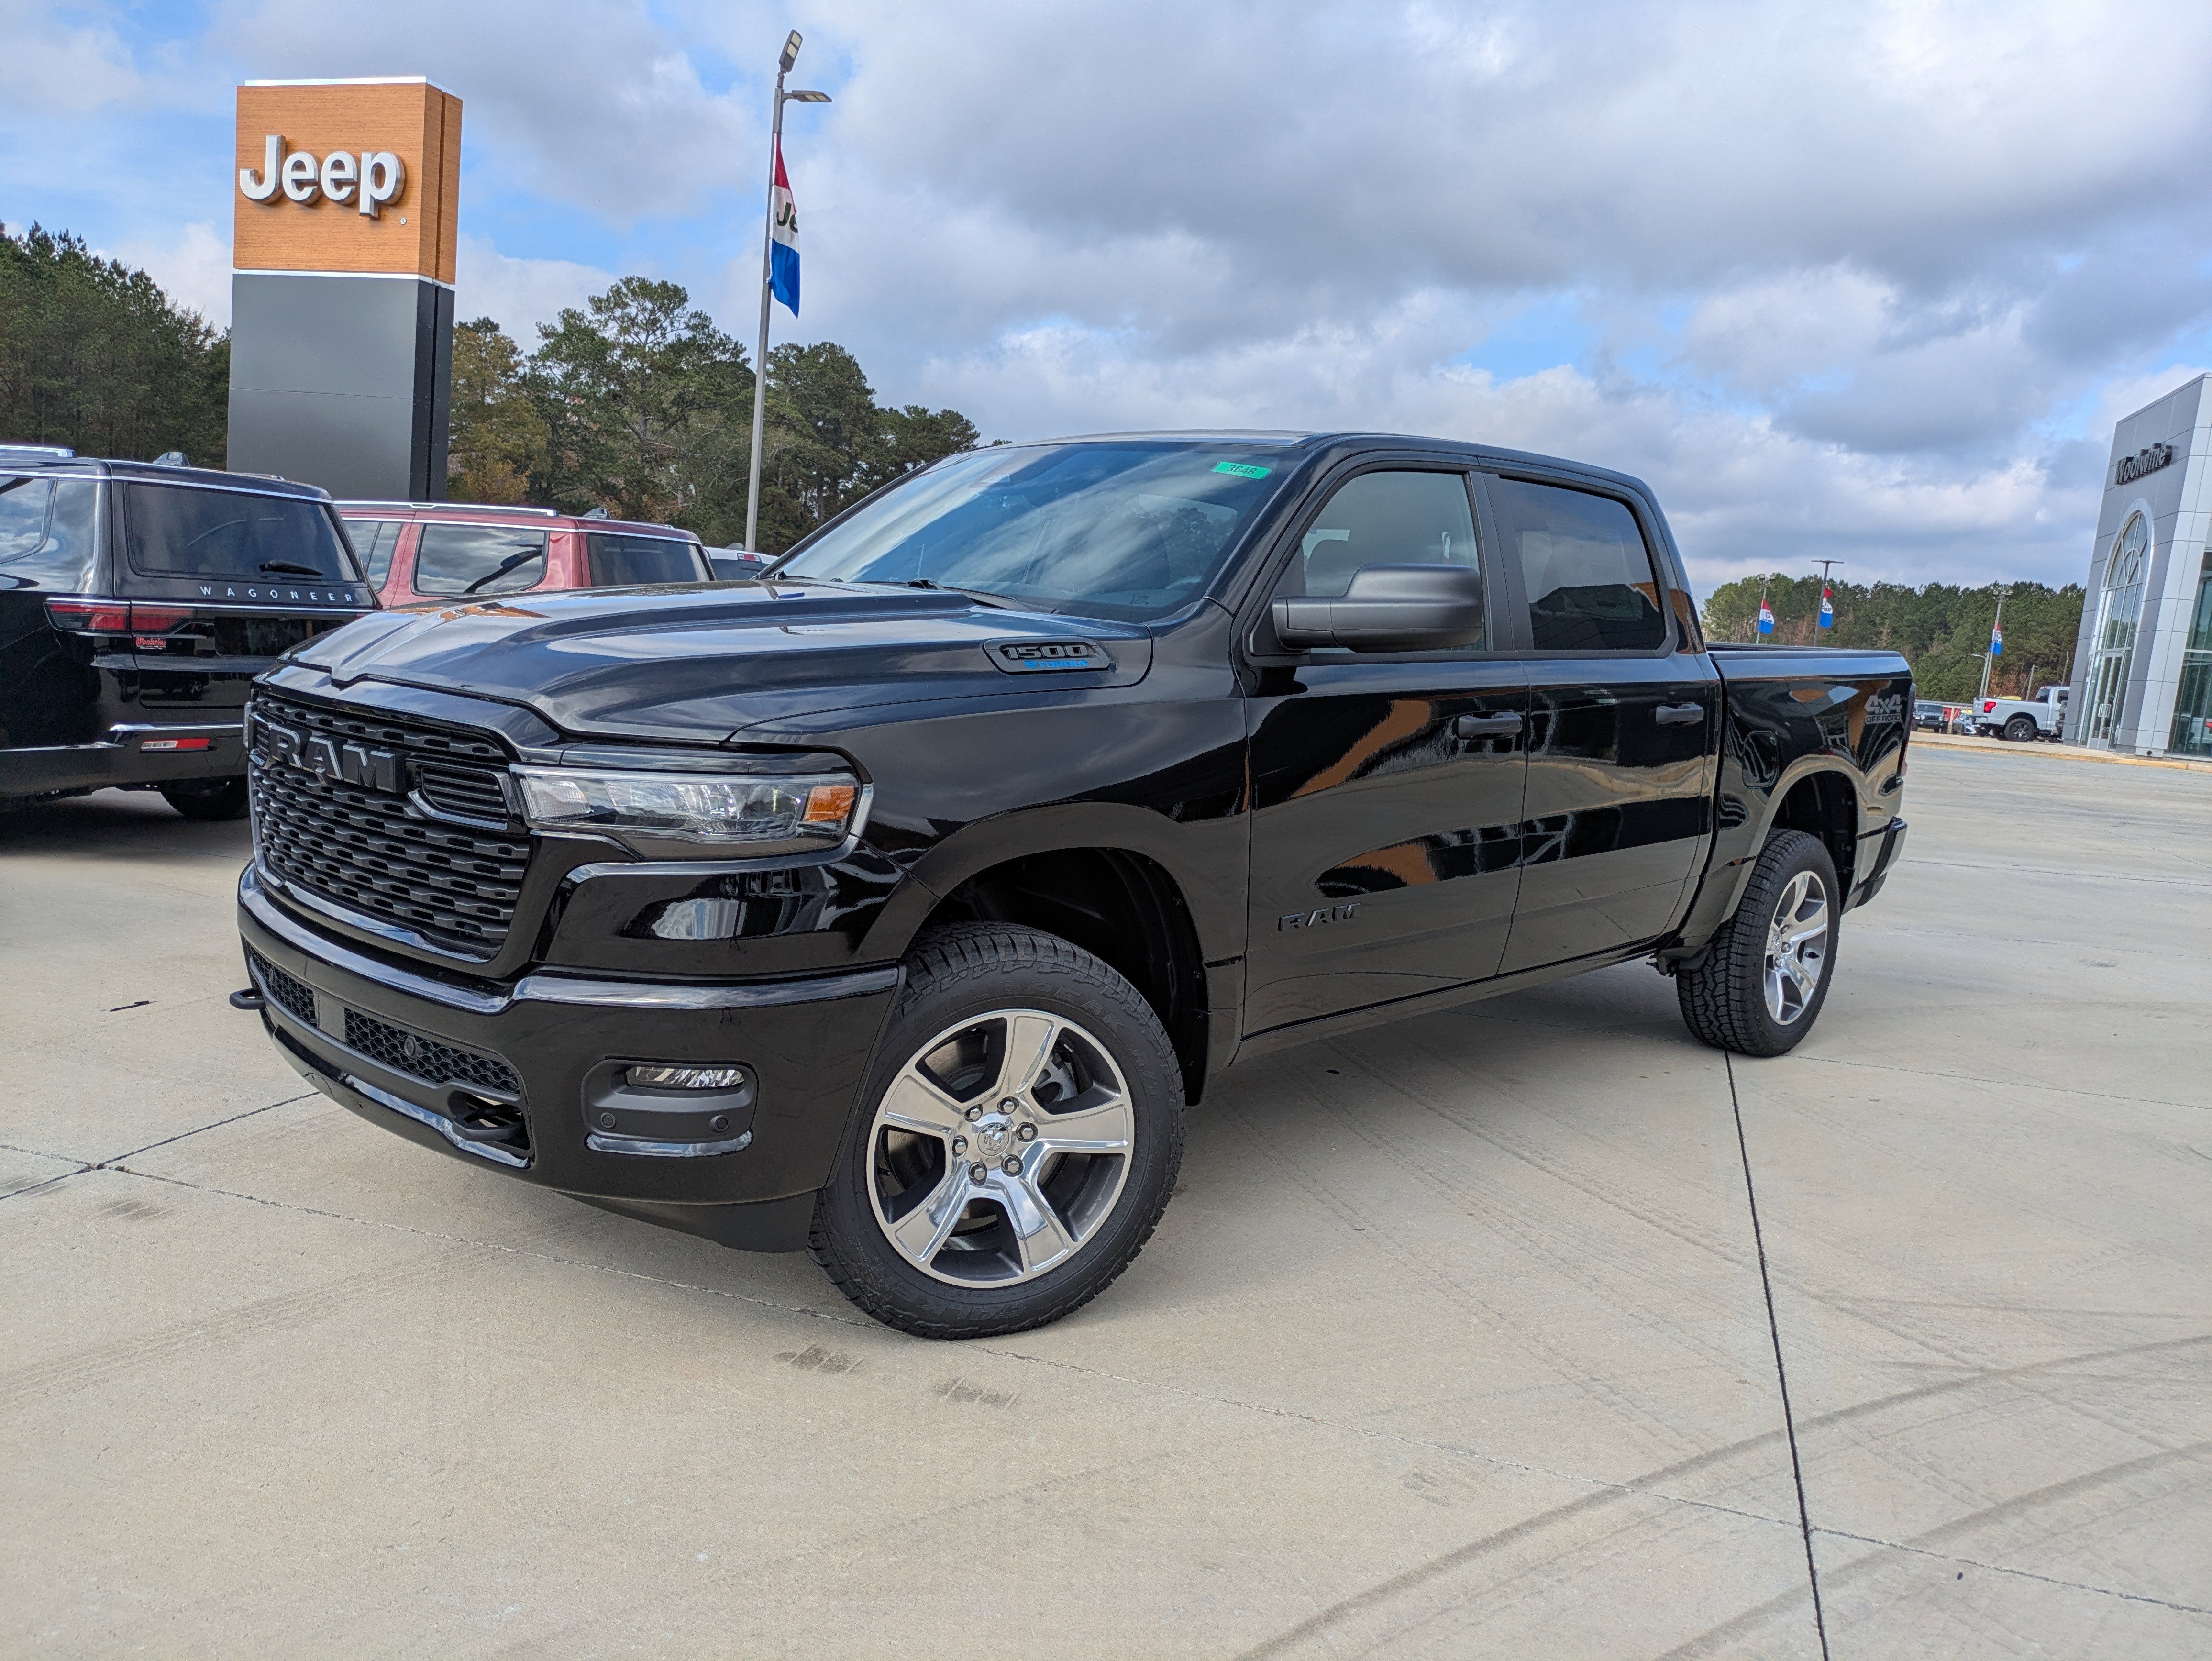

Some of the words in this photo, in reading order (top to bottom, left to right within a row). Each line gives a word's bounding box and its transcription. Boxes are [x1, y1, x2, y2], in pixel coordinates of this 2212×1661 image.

[239, 134, 405, 218] Jeep
[1226, 464, 1257, 476] 3648
[2114, 443, 2172, 485] Woolwine
[200, 586, 353, 602] WAGONEER
[1003, 645, 1088, 659] 1500
[268, 724, 398, 793] RAM
[1277, 902, 1361, 932] RAM
